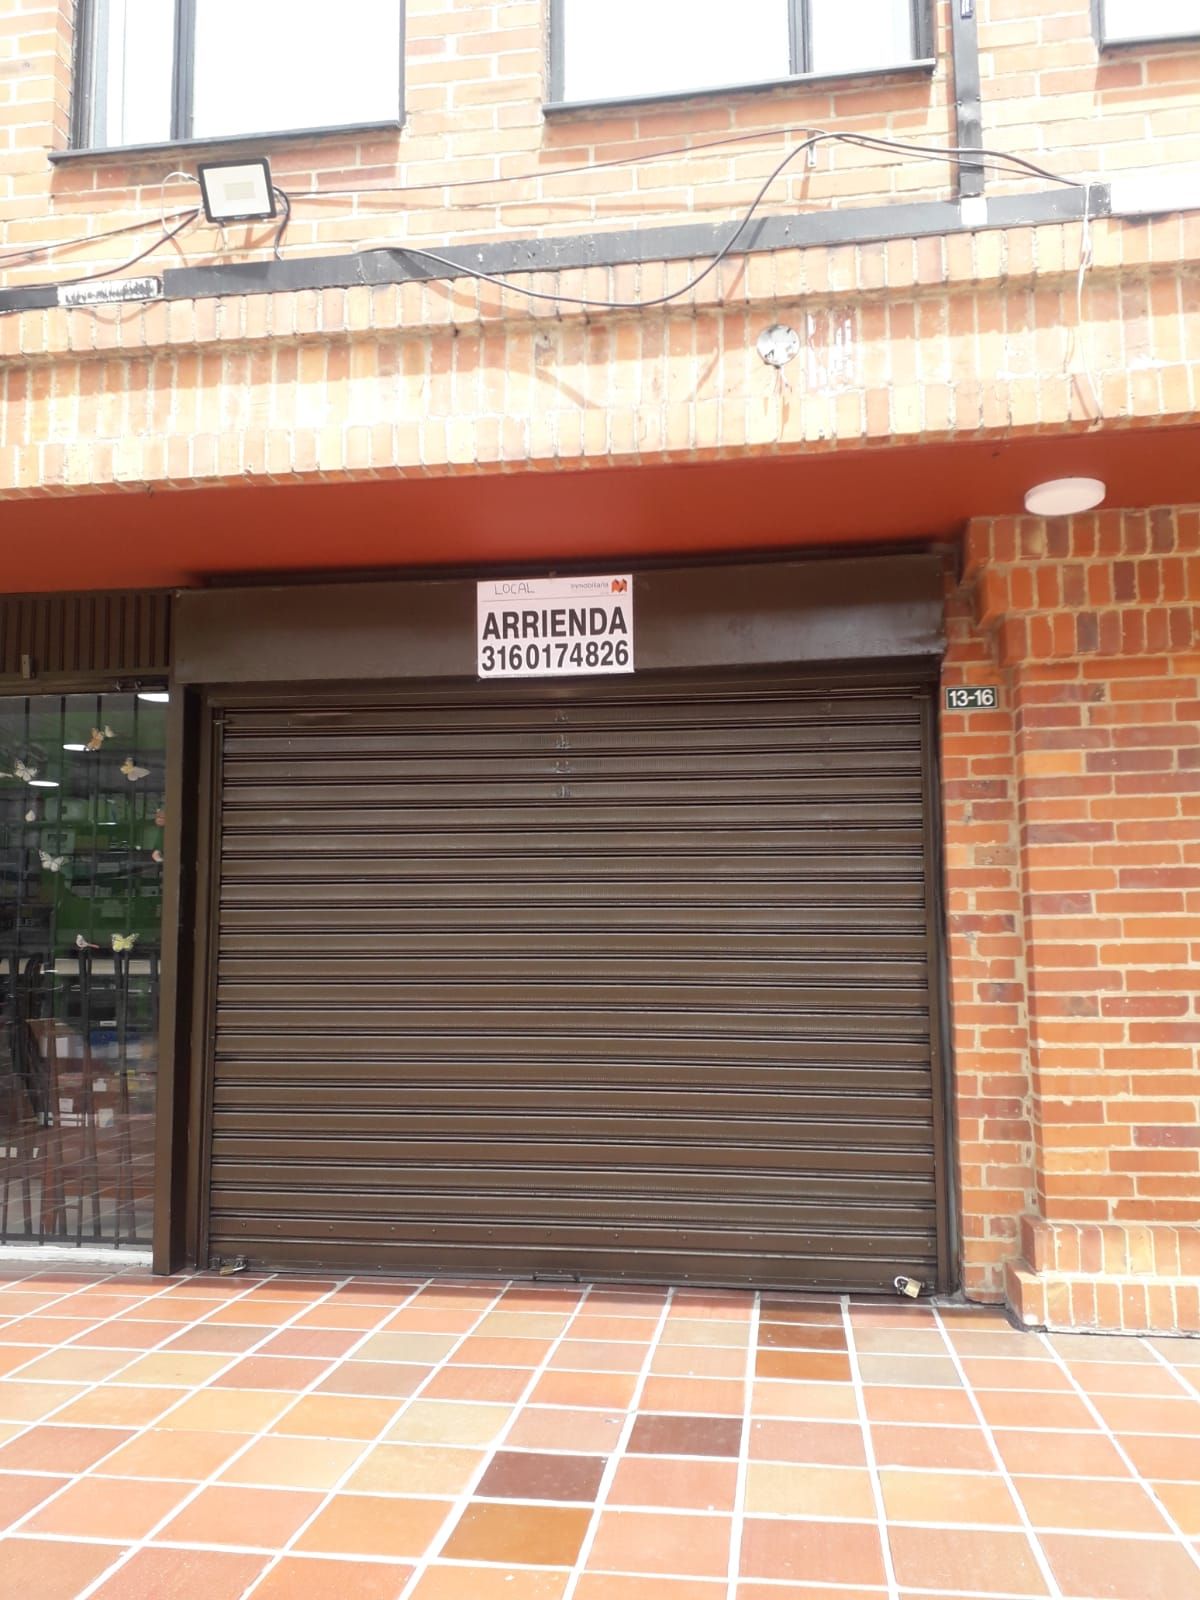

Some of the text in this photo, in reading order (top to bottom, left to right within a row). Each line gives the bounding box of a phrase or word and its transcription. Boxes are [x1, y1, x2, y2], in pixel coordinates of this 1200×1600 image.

[494, 582, 536, 595] LOCAL
[482, 606, 628, 640] ARRIENDA
[481, 640, 629, 671] 3160174826
[949, 688, 994, 707] 13-16
